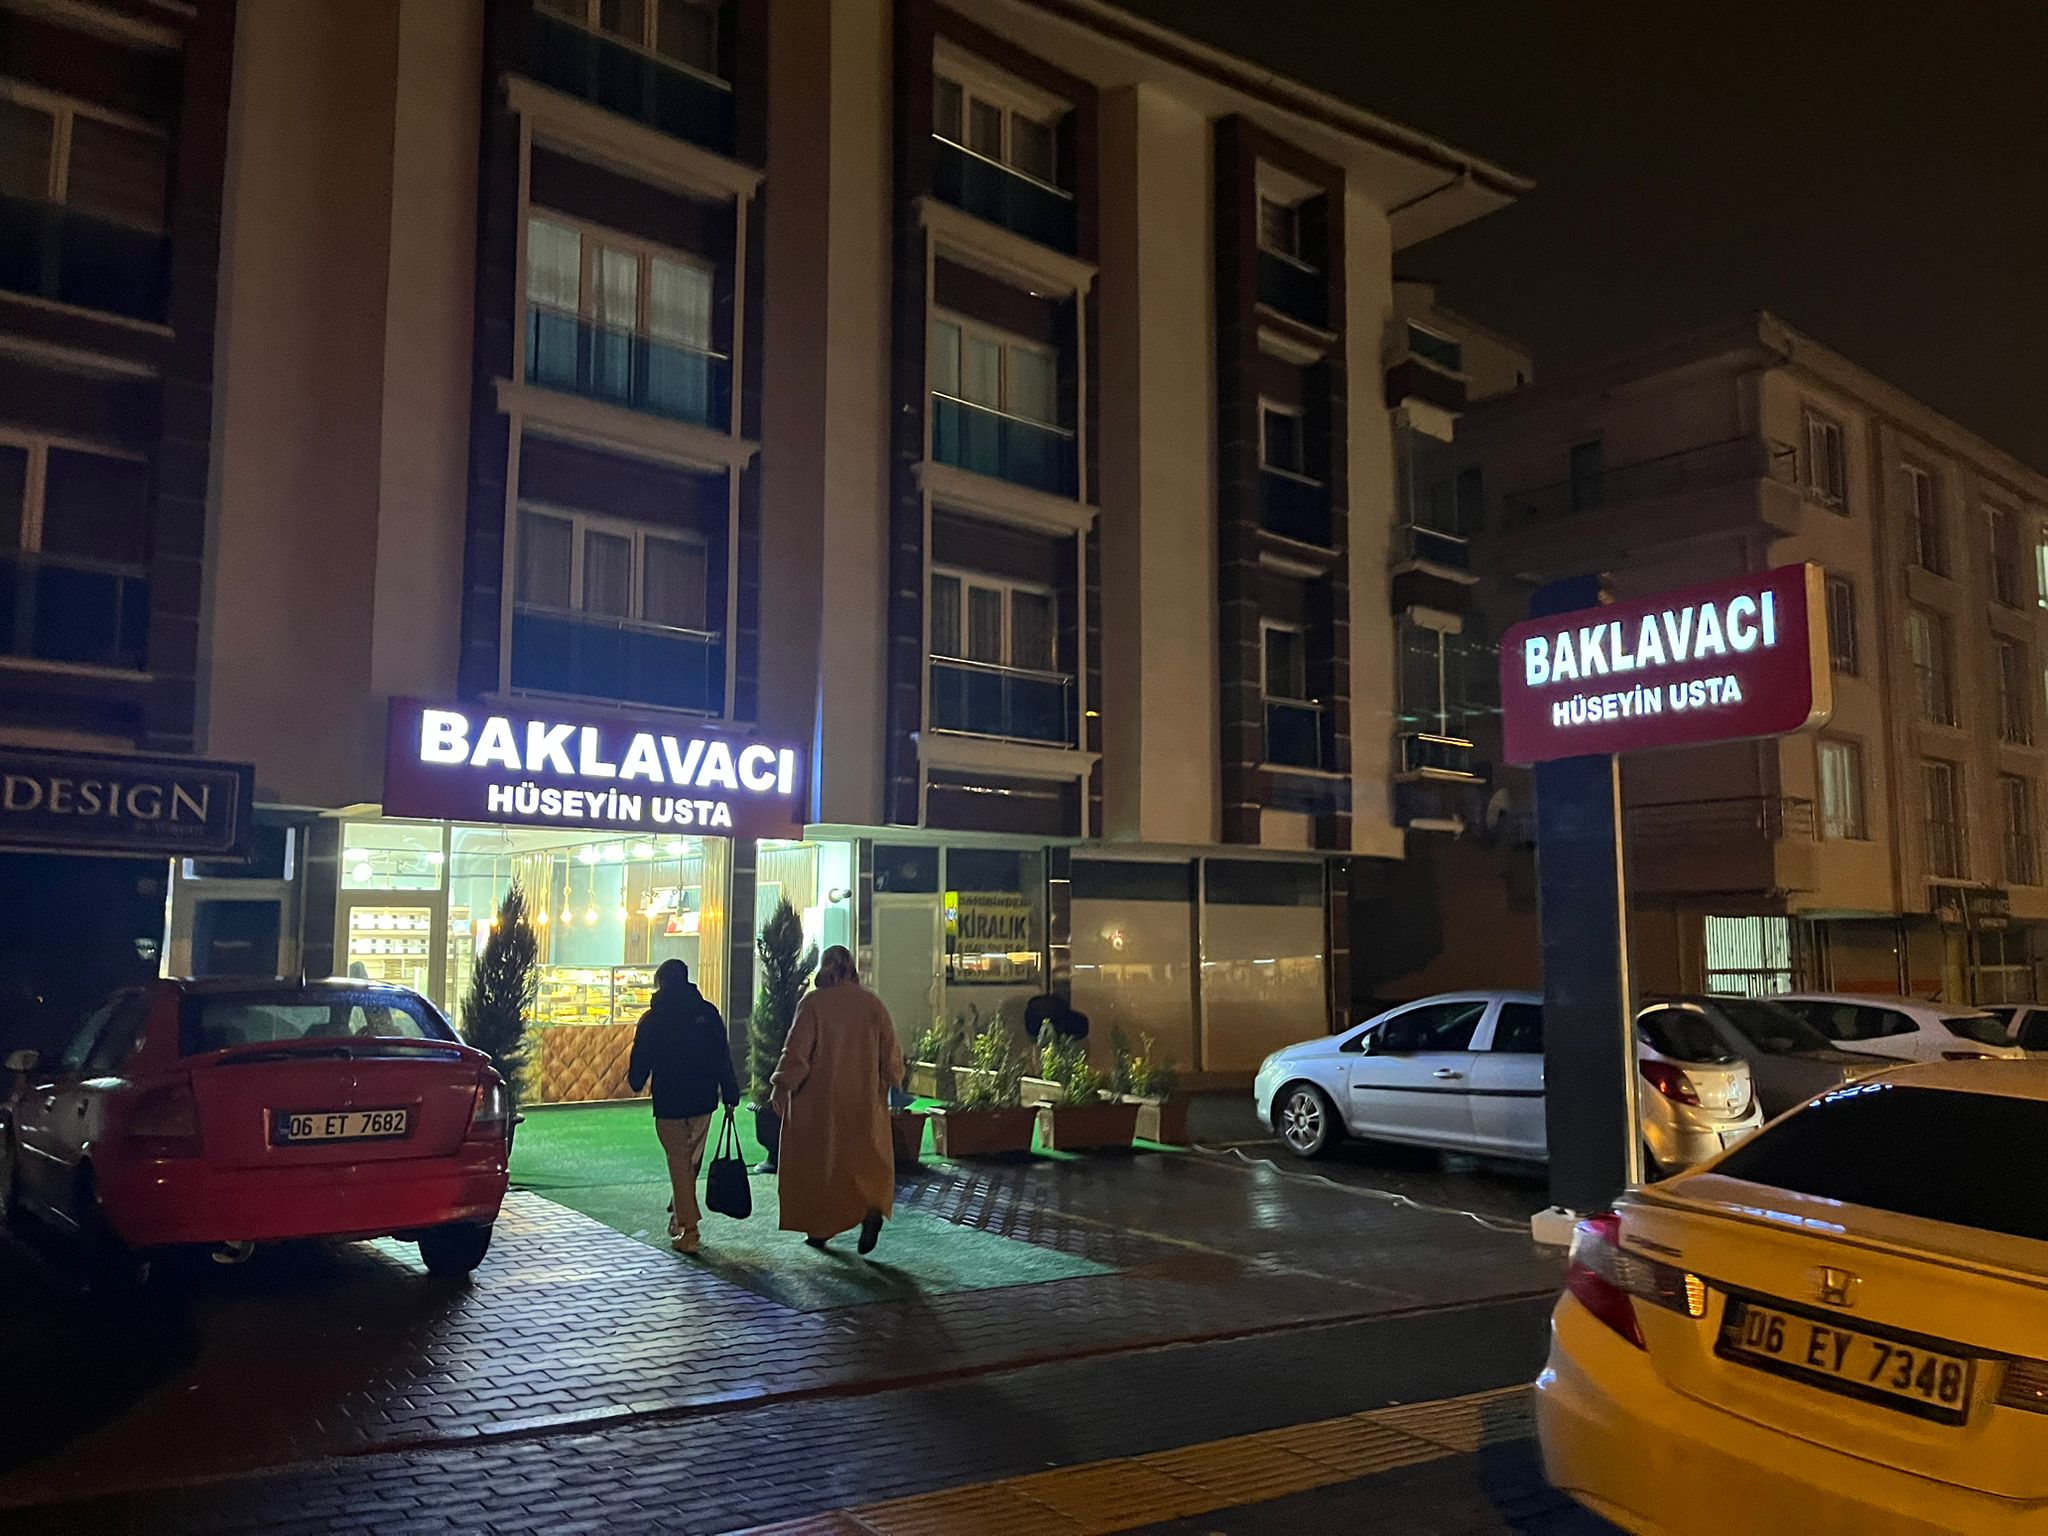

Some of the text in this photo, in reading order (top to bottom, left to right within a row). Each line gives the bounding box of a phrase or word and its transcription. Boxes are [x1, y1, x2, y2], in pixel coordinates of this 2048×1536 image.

[1525, 590, 1777, 687] BAKLAVACI
[1552, 674, 1743, 726] HÜSEYİN USTA
[420, 708, 795, 794] BAKLAVACI
[3, 774, 211, 824] DESIGN
[487, 781, 733, 828] HÜSEYİN USTA
[290, 1113, 405, 1136] 06 ET 7682
[1746, 1310, 1786, 1354] 06
[1807, 1326, 1853, 1373] EY
[1868, 1341, 1963, 1403] 7348
